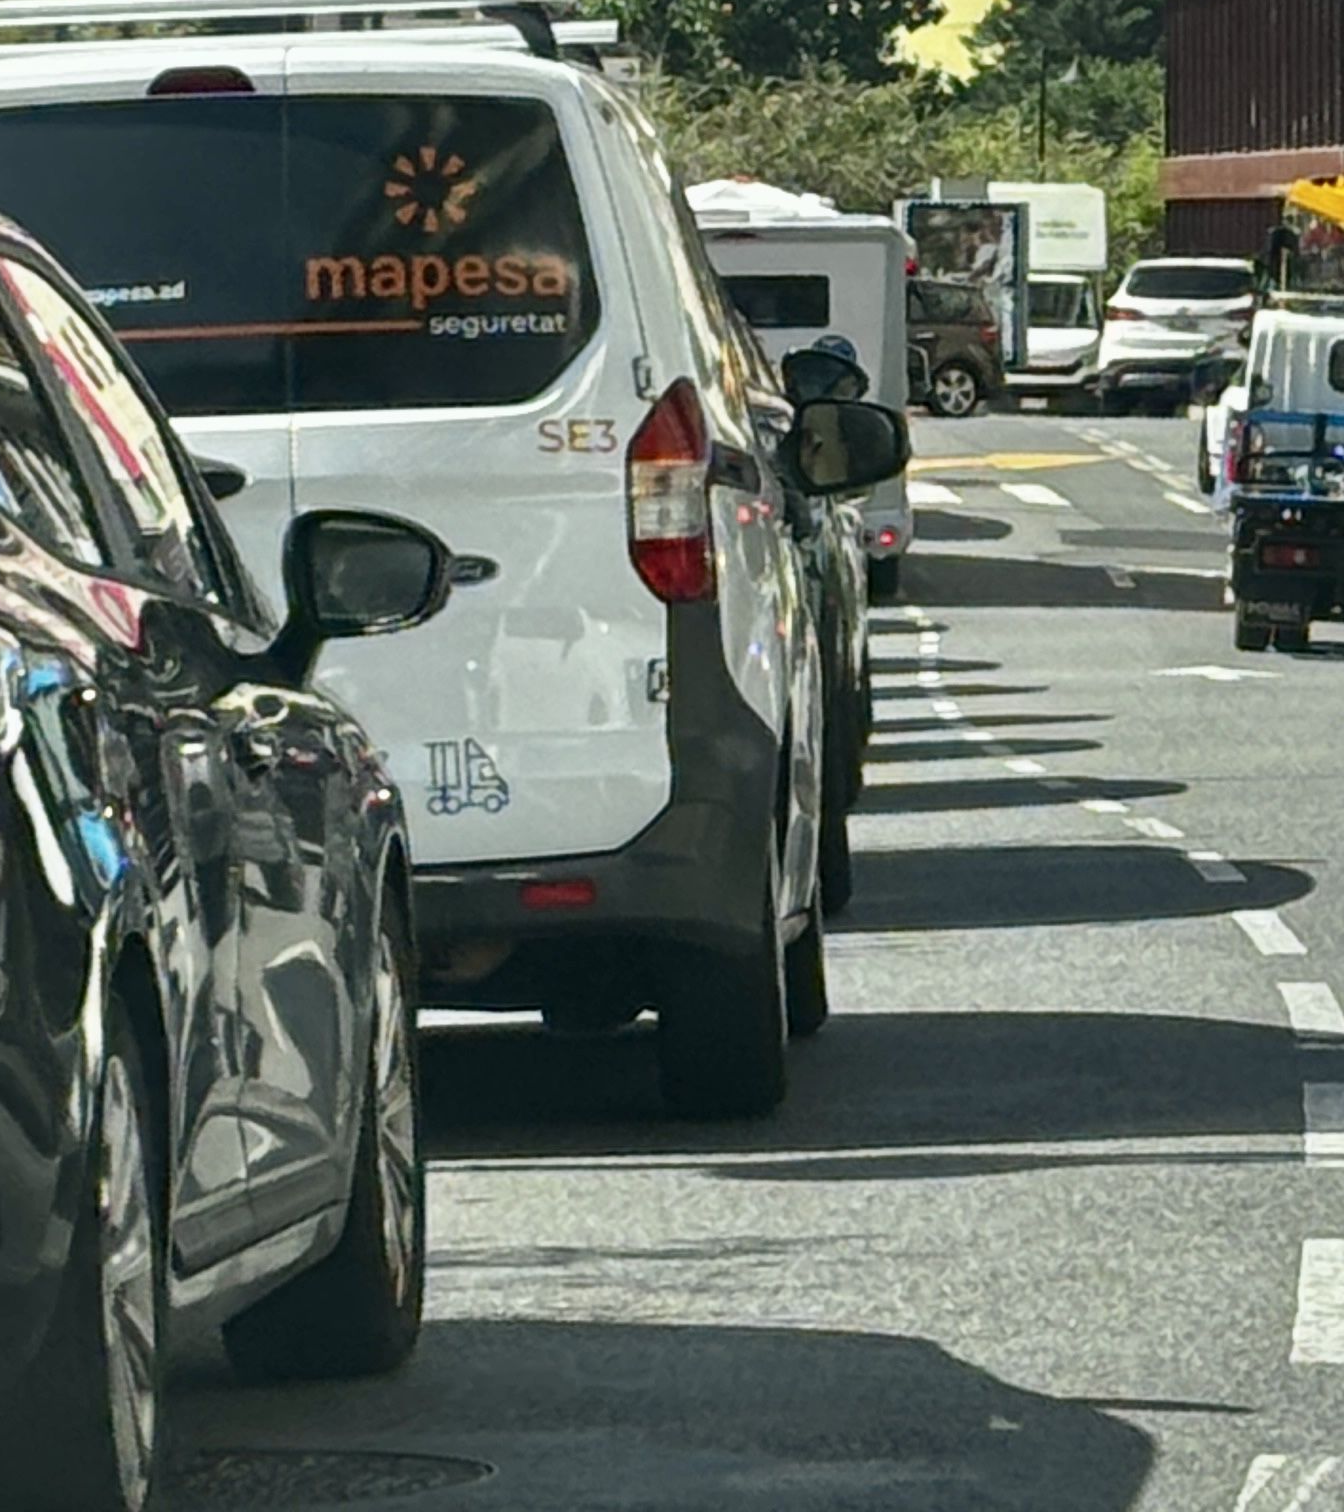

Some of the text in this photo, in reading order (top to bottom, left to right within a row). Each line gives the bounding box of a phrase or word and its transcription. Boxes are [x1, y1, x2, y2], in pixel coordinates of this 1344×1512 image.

[306, 251, 569, 310] mapesa
[429, 313, 568, 338] seguretat
[537, 419, 618, 454] SE3
